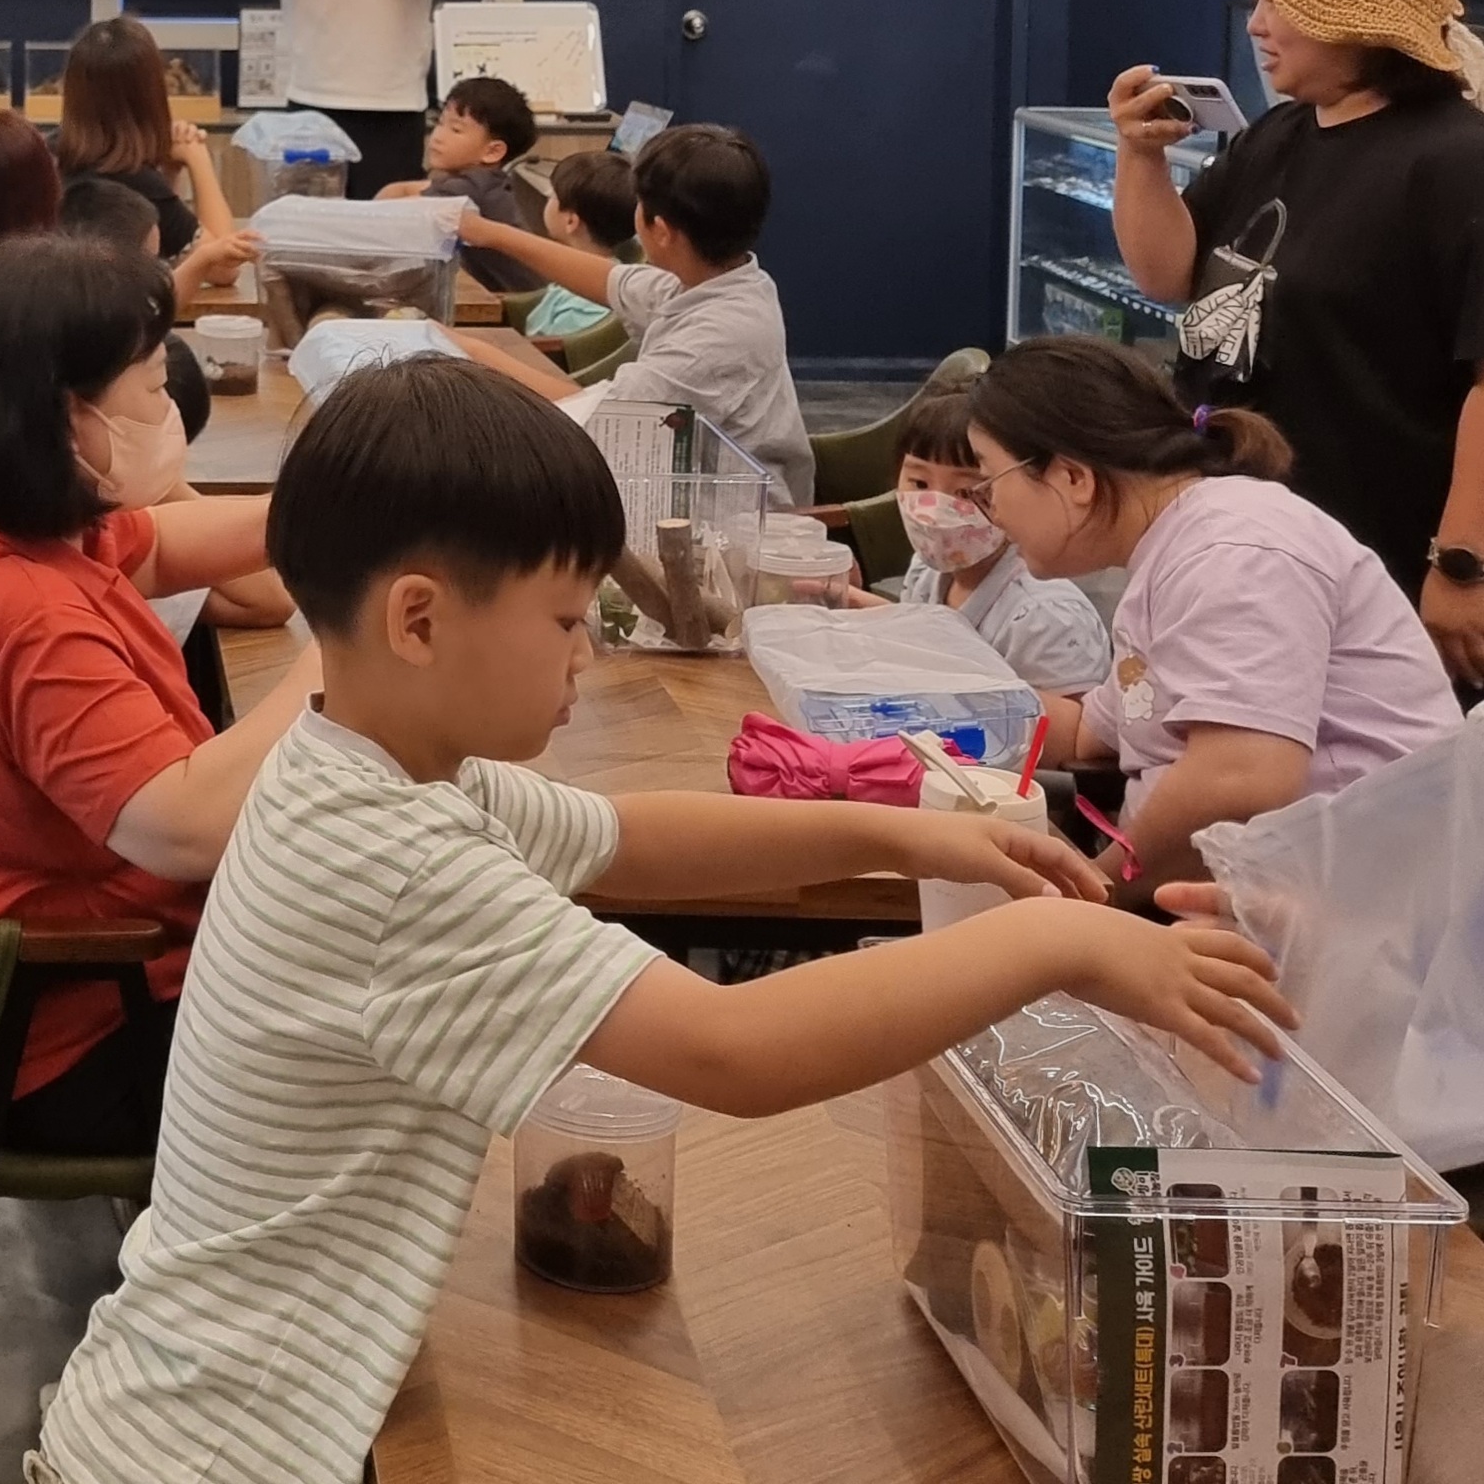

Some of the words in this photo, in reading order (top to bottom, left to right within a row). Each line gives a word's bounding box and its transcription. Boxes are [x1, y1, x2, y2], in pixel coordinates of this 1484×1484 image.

[1134, 1236, 1154, 1286] 가이드
[1136, 1290, 1156, 1322] 사육
[1133, 1326, 1155, 1430] 산란세트(특대)
[1132, 1433, 1153, 1464] 실속
